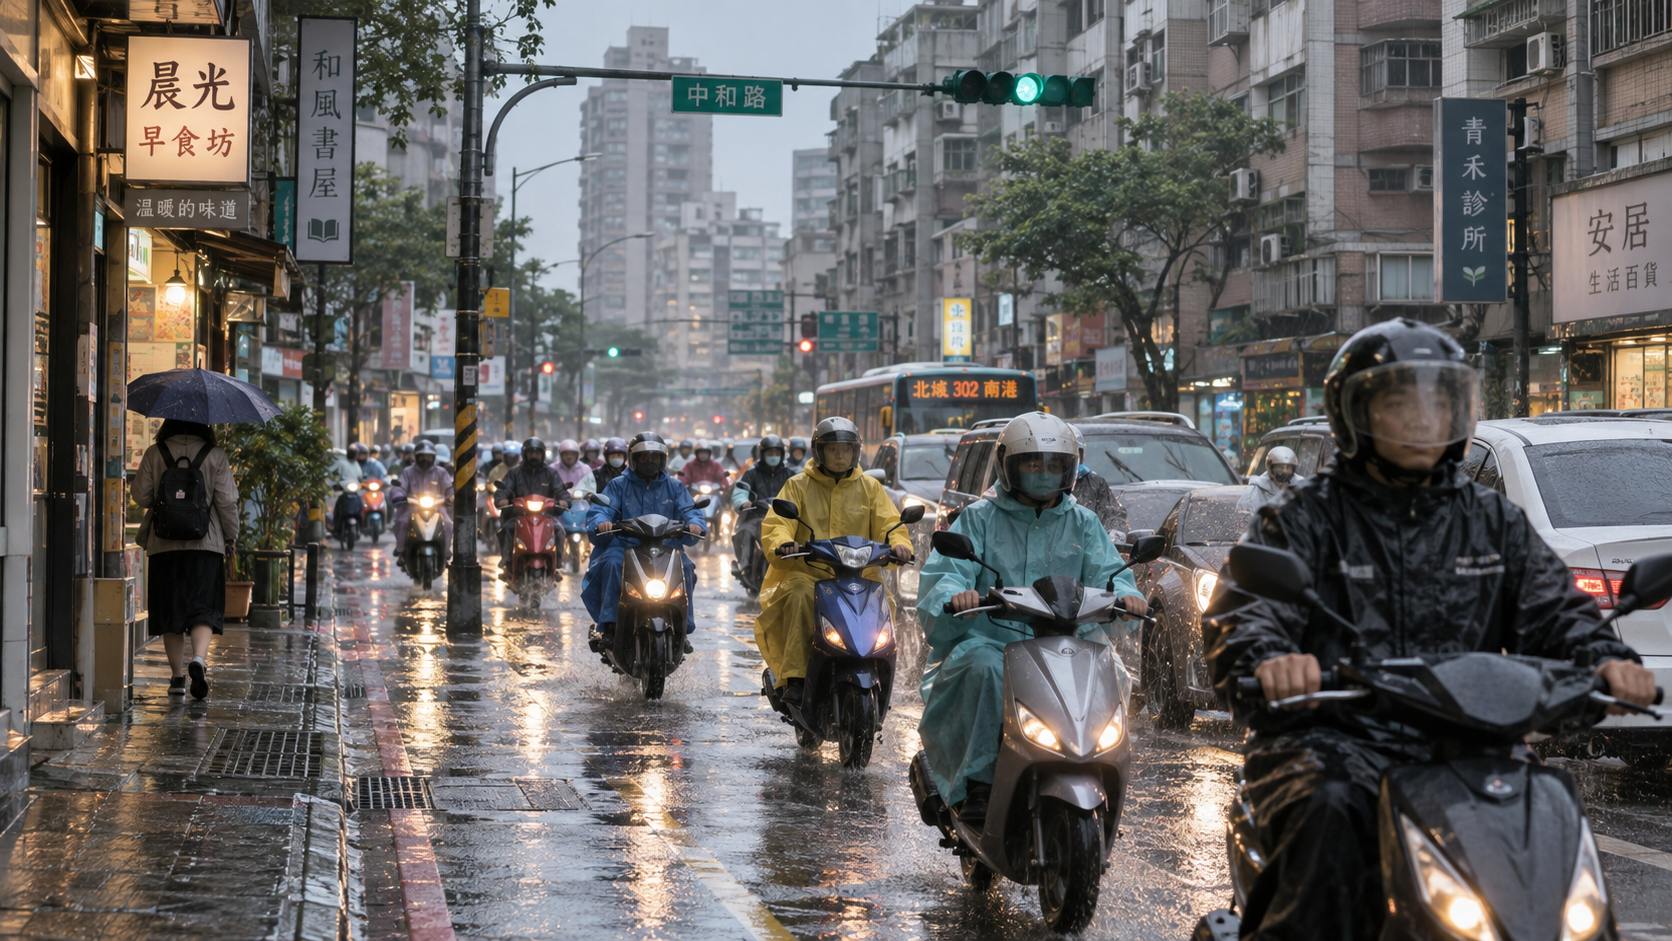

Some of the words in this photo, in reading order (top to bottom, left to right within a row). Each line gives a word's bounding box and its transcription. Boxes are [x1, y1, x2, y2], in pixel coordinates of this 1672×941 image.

[141, 61, 235, 111] 晨光
[687, 82, 766, 110] 中和路
[138, 125, 235, 158] 早食坊
[309, 49, 342, 199] 和風書屋
[1461, 116, 1488, 253] 青禾診所
[1587, 202, 1650, 256] 安居
[1588, 262, 1658, 295] 生活百貨
[953, 380, 979, 398] 302
[984, 379, 1018, 399] 南港
